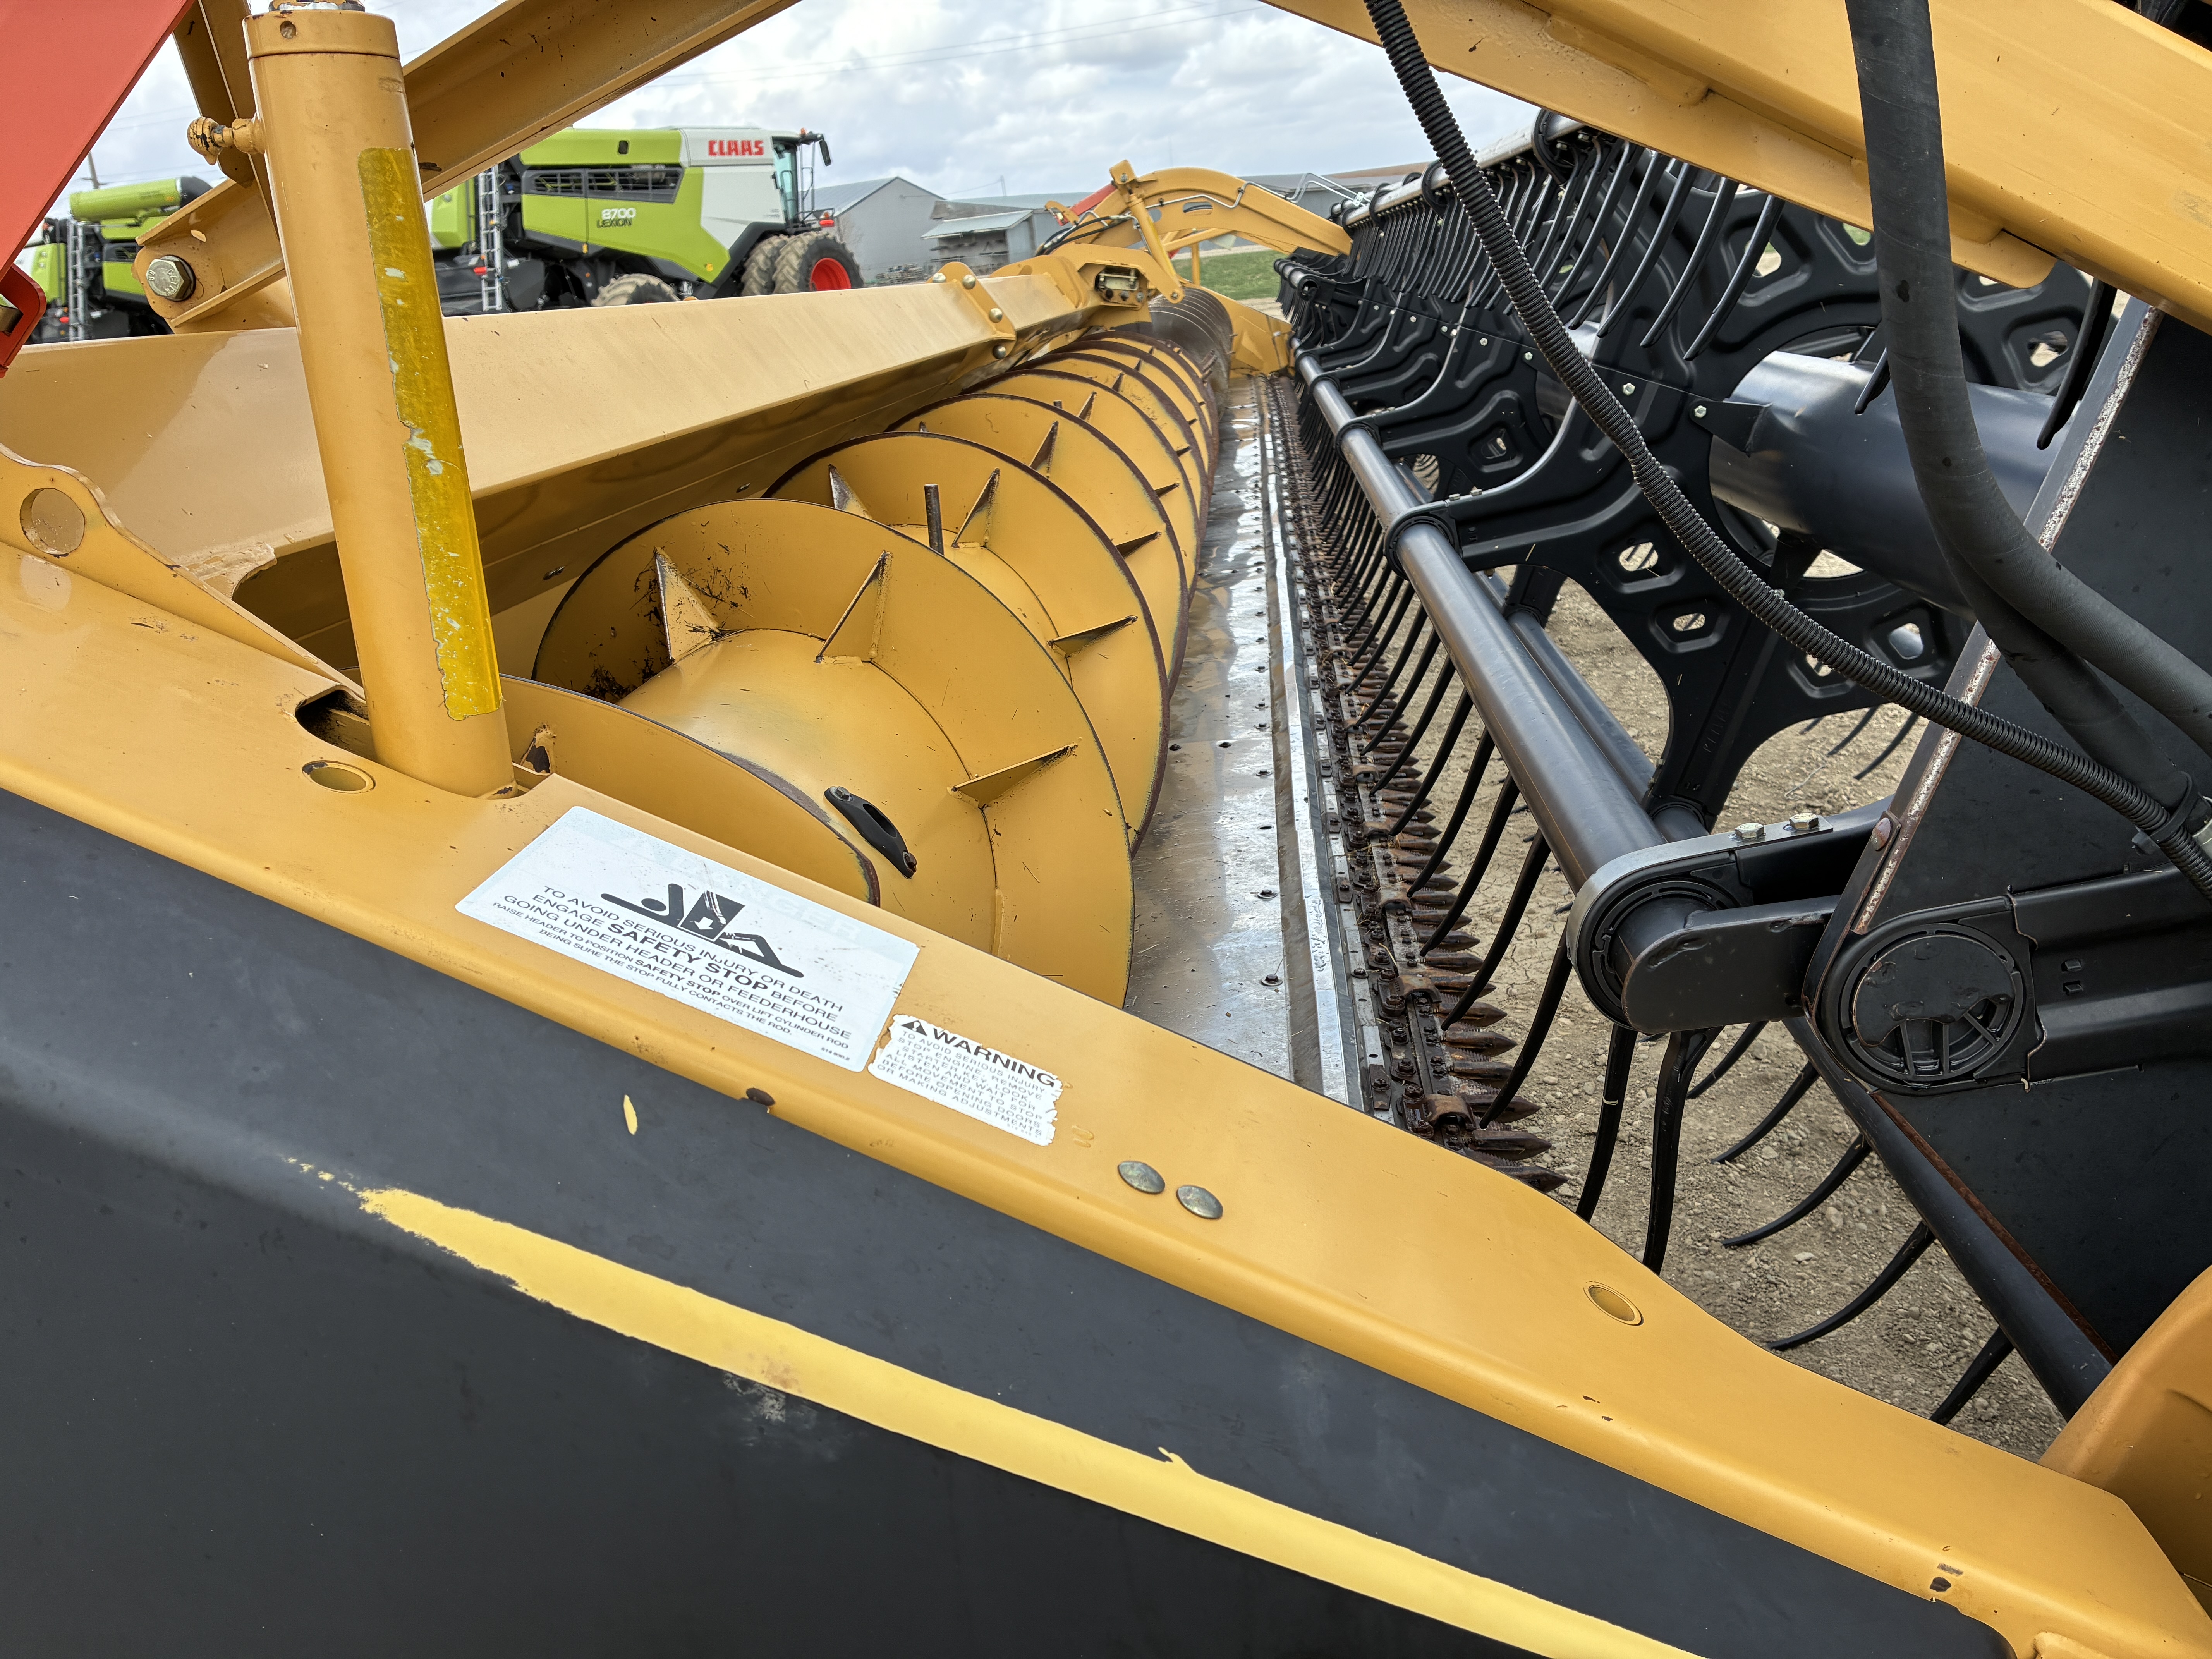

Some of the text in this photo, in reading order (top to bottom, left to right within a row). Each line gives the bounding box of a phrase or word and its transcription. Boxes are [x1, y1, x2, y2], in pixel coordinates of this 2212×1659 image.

[708, 139, 764, 156] CLAAS
[596, 217, 633, 228] LEXION
[601, 208, 637, 219] 8700
[493, 902, 848, 1048] RAISE HEADER TO POSITION SAFETY STOP OVER LIFT CYLINDER ROD
[504, 896, 851, 1039] GOING UNDER HEADER OR FEEDERHOUSE
[532, 895, 837, 1022] ENGAGE SAFETY STOP BEFORE
[544, 886, 843, 1012] TO AVOID SERIOUS INJURY OR DEATH
[539, 929, 792, 1035] BEING SURE THE STOP FULLY CONTACTS THE ROD.
[886, 1054, 1042, 1120] ALL MOVEMENT TO STOP
[896, 1050, 1035, 1111] LISTEN AND WAIT FOR
[897, 1037, 931, 1052] STOP
[992, 1075, 1042, 1100] REMOVE
[902, 1046, 958, 1072] STARTER
[903, 1031, 1045, 1093] TO AVOID SERIOUS INJURY
[934, 1028, 1054, 1087] WARNING
[877, 1064, 894, 1075] OR
[899, 1073, 946, 1096] MAKING
[952, 1095, 1042, 1136] ADJUSTMENTS
[882, 1059, 1040, 1128] BEFORE OPENING DOORS
